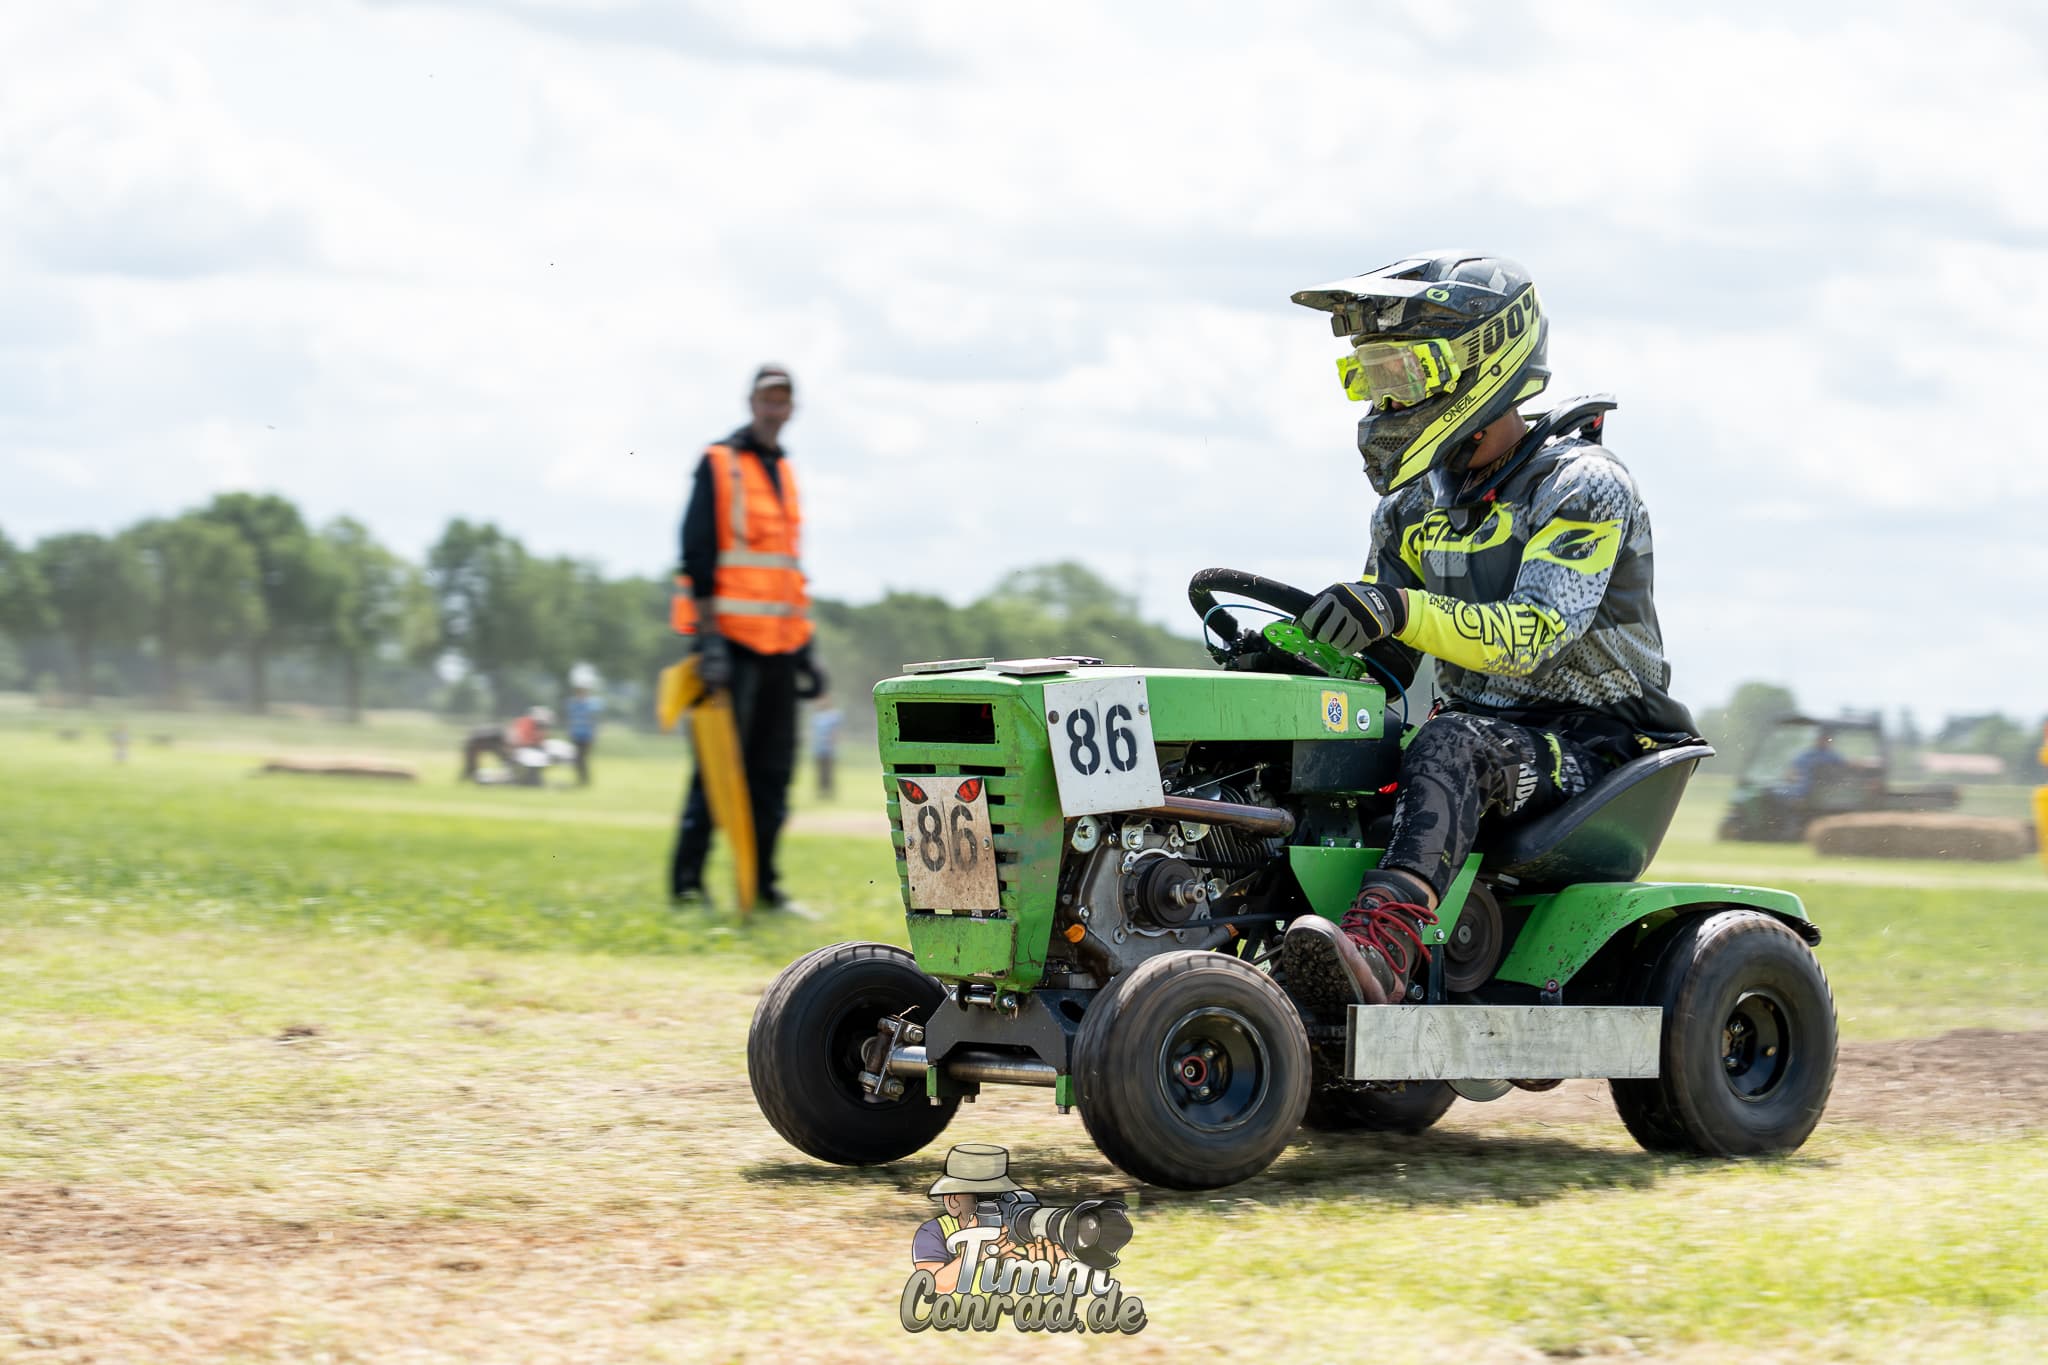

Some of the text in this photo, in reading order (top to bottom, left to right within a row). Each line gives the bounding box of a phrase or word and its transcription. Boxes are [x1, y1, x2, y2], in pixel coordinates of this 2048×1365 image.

[1461, 284, 1540, 366] 100%
[1442, 394, 1477, 423] ONEAL
[1066, 704, 1138, 776] 86
[917, 804, 978, 873] 86
